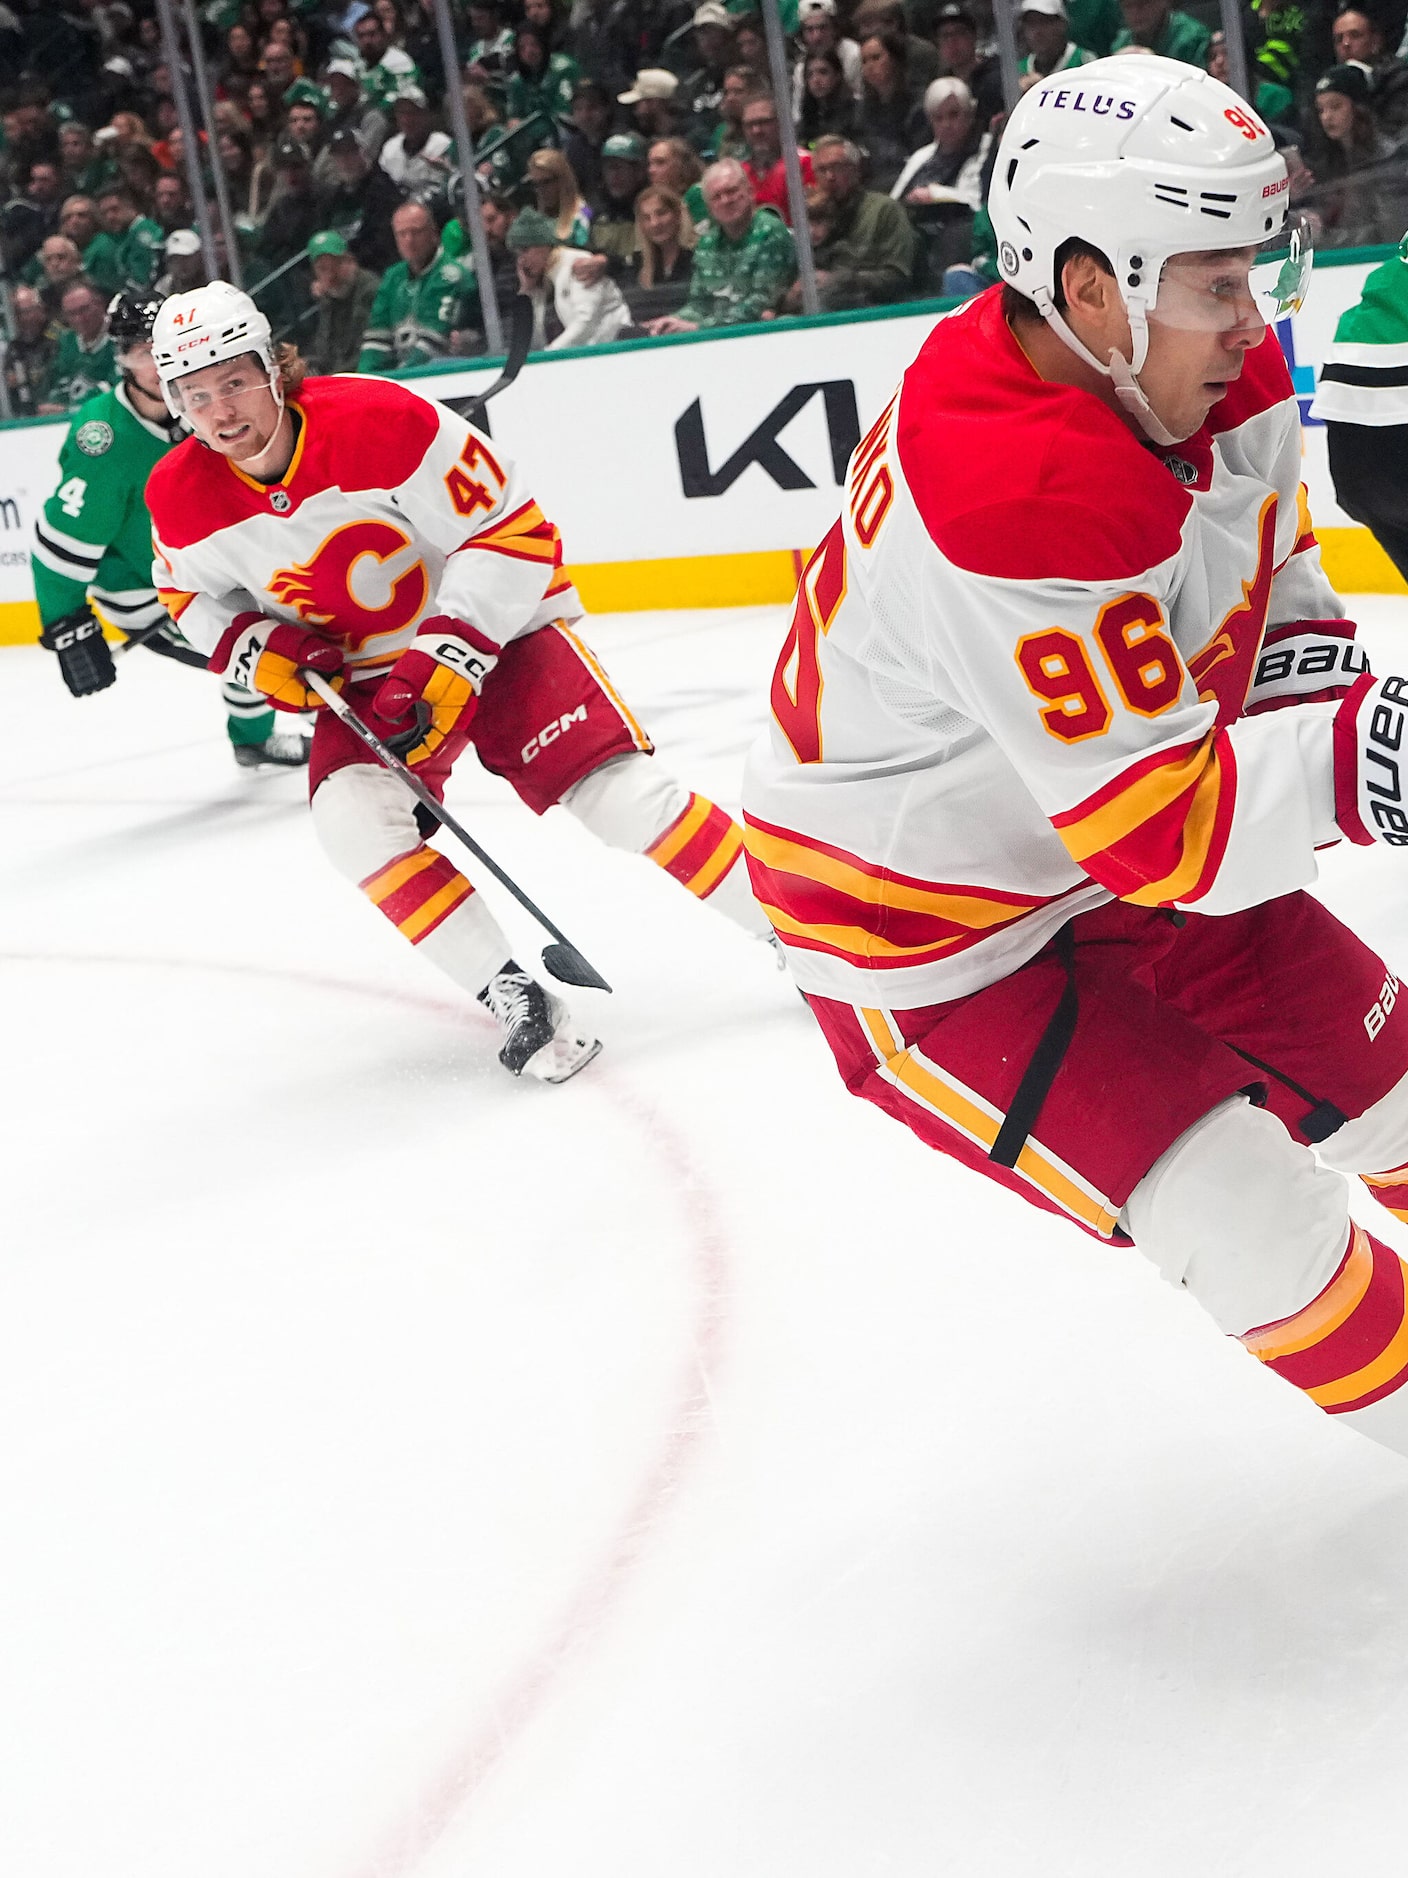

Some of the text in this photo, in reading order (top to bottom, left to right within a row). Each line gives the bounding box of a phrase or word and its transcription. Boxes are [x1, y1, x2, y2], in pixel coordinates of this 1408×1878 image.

[1038, 89, 1137, 120] TELUS
[443, 433, 507, 517] 47
[57, 476, 87, 518] 4
[54, 620, 99, 651] CC
[436, 643, 488, 683] CC
[1013, 590, 1185, 745] 96
[521, 704, 588, 764] CCM
